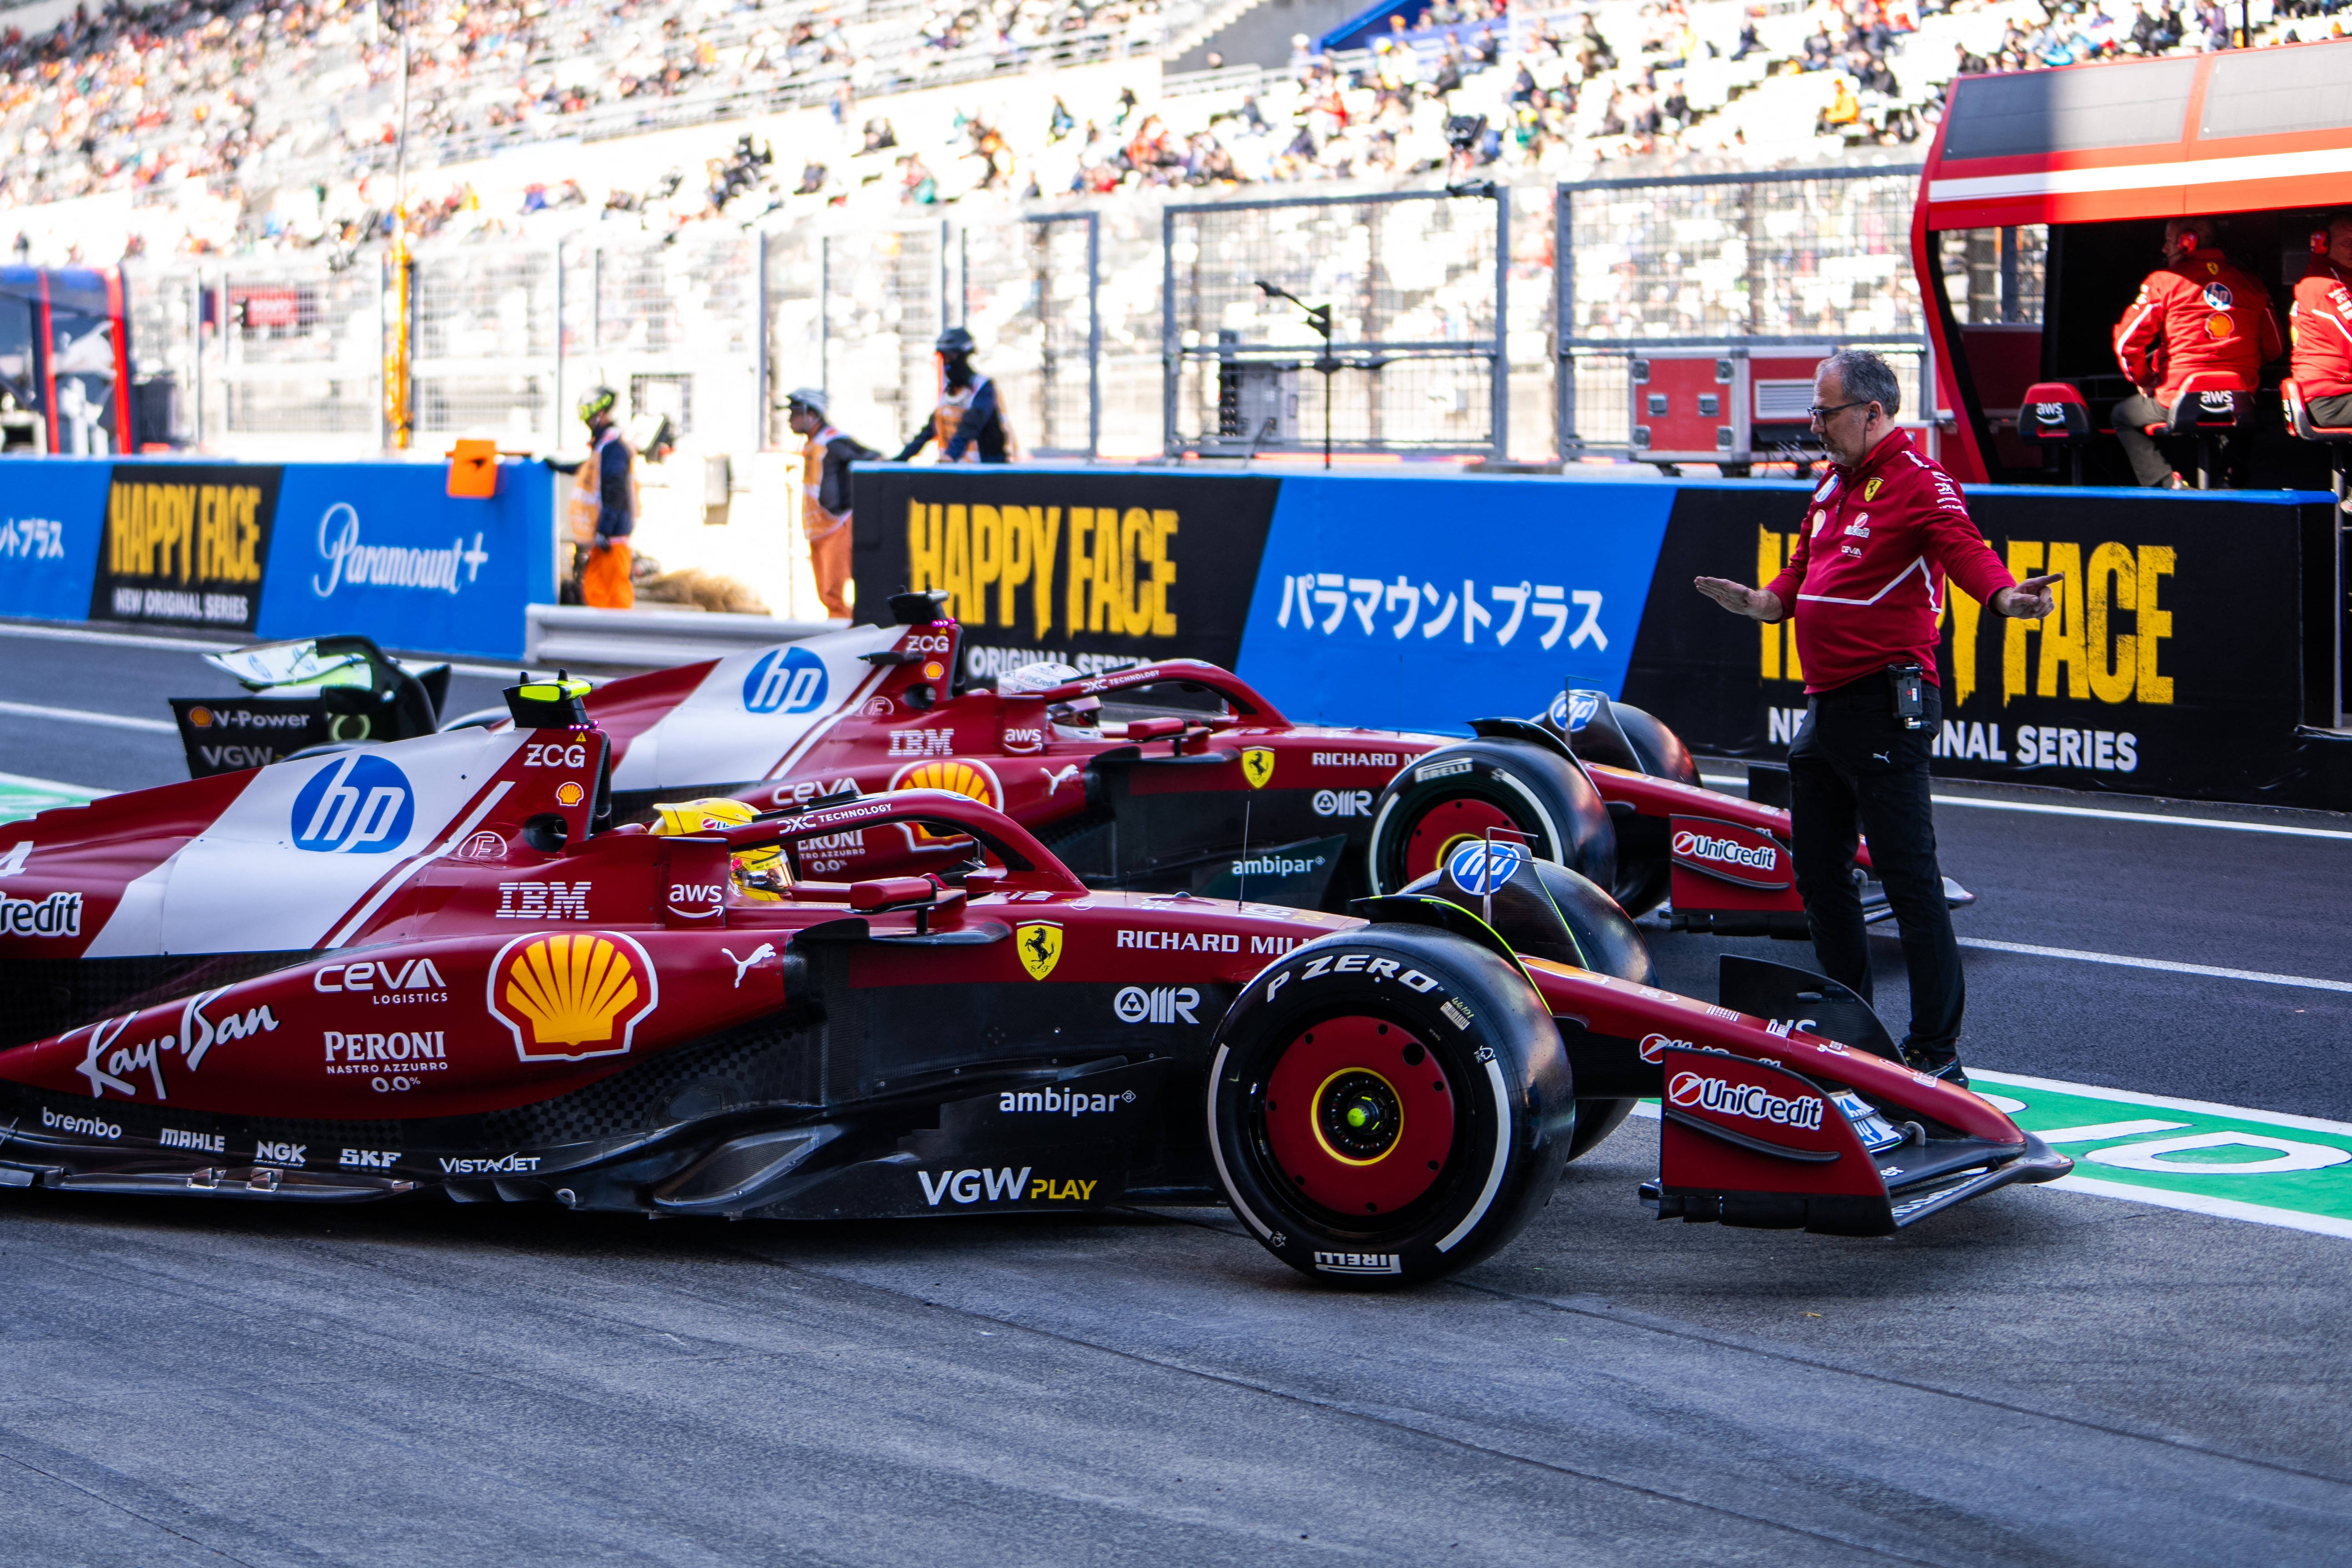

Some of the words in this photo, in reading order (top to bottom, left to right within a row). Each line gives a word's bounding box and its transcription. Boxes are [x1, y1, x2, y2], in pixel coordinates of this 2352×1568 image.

[2036, 402, 2064, 416] aws
[2201, 391, 2233, 404] aws
[109, 481, 196, 586] HAPPY
[198, 484, 262, 582] FACE
[313, 502, 489, 597] Paramount+
[908, 497, 1061, 640] HAPPY
[1066, 505, 1179, 641] FACE
[114, 587, 141, 614] NEW
[145, 590, 202, 618] ORIGINAL
[204, 594, 249, 623] SERIES
[1276, 573, 1608, 652] パラマウントプラス
[2003, 536, 2177, 708] FACE
[906, 635, 949, 653] ZCG
[749, 646, 823, 714] hp
[1108, 670, 1160, 686] TECHNOLOGY
[213, 709, 310, 727] V-Power
[888, 728, 954, 756] IBM
[1005, 728, 1042, 742] aws
[1932, 719, 2007, 763] INAL
[2016, 724, 2138, 773] SERIES
[201, 746, 273, 767] VGW
[524, 743, 586, 767] ZCG
[1312, 752, 1397, 767] RICHARD
[1415, 757, 1473, 782] PIRELLI
[299, 754, 406, 853] hp
[777, 815, 817, 835] DXC
[818, 803, 892, 824] TECHNOLOGY
[798, 829, 864, 851] RONI
[821, 848, 866, 858] AZZURRO
[1693, 835, 1777, 871] UniCredit
[1232, 856, 1314, 877] ambipar
[495, 881, 591, 920] IBM
[669, 884, 723, 902] aws
[0, 891, 83, 937] redit
[1117, 930, 1240, 952] RICHARD
[1251, 936, 1310, 954] MIL
[1266, 971, 1290, 1002] P
[1301, 954, 1439, 994] ZERO
[373, 992, 448, 1005] LOGISTICS
[324, 1030, 446, 1062] PERONI
[326, 1064, 379, 1074] NASTRO
[383, 1061, 448, 1072] AZZURRO
[371, 1075, 421, 1092] 0.0%
[1000, 1087, 1120, 1117] ambipar
[1700, 1076, 1824, 1131] UniCredit
[42, 1106, 122, 1140] brembo
[160, 1128, 225, 1153] MAHLE
[256, 1140, 307, 1163] NGK
[339, 1148, 401, 1167] SKF
[917, 1167, 1032, 1206] VGW
[1031, 1179, 1097, 1200] PLAY
[1314, 1251, 1402, 1274] PIRELLI
